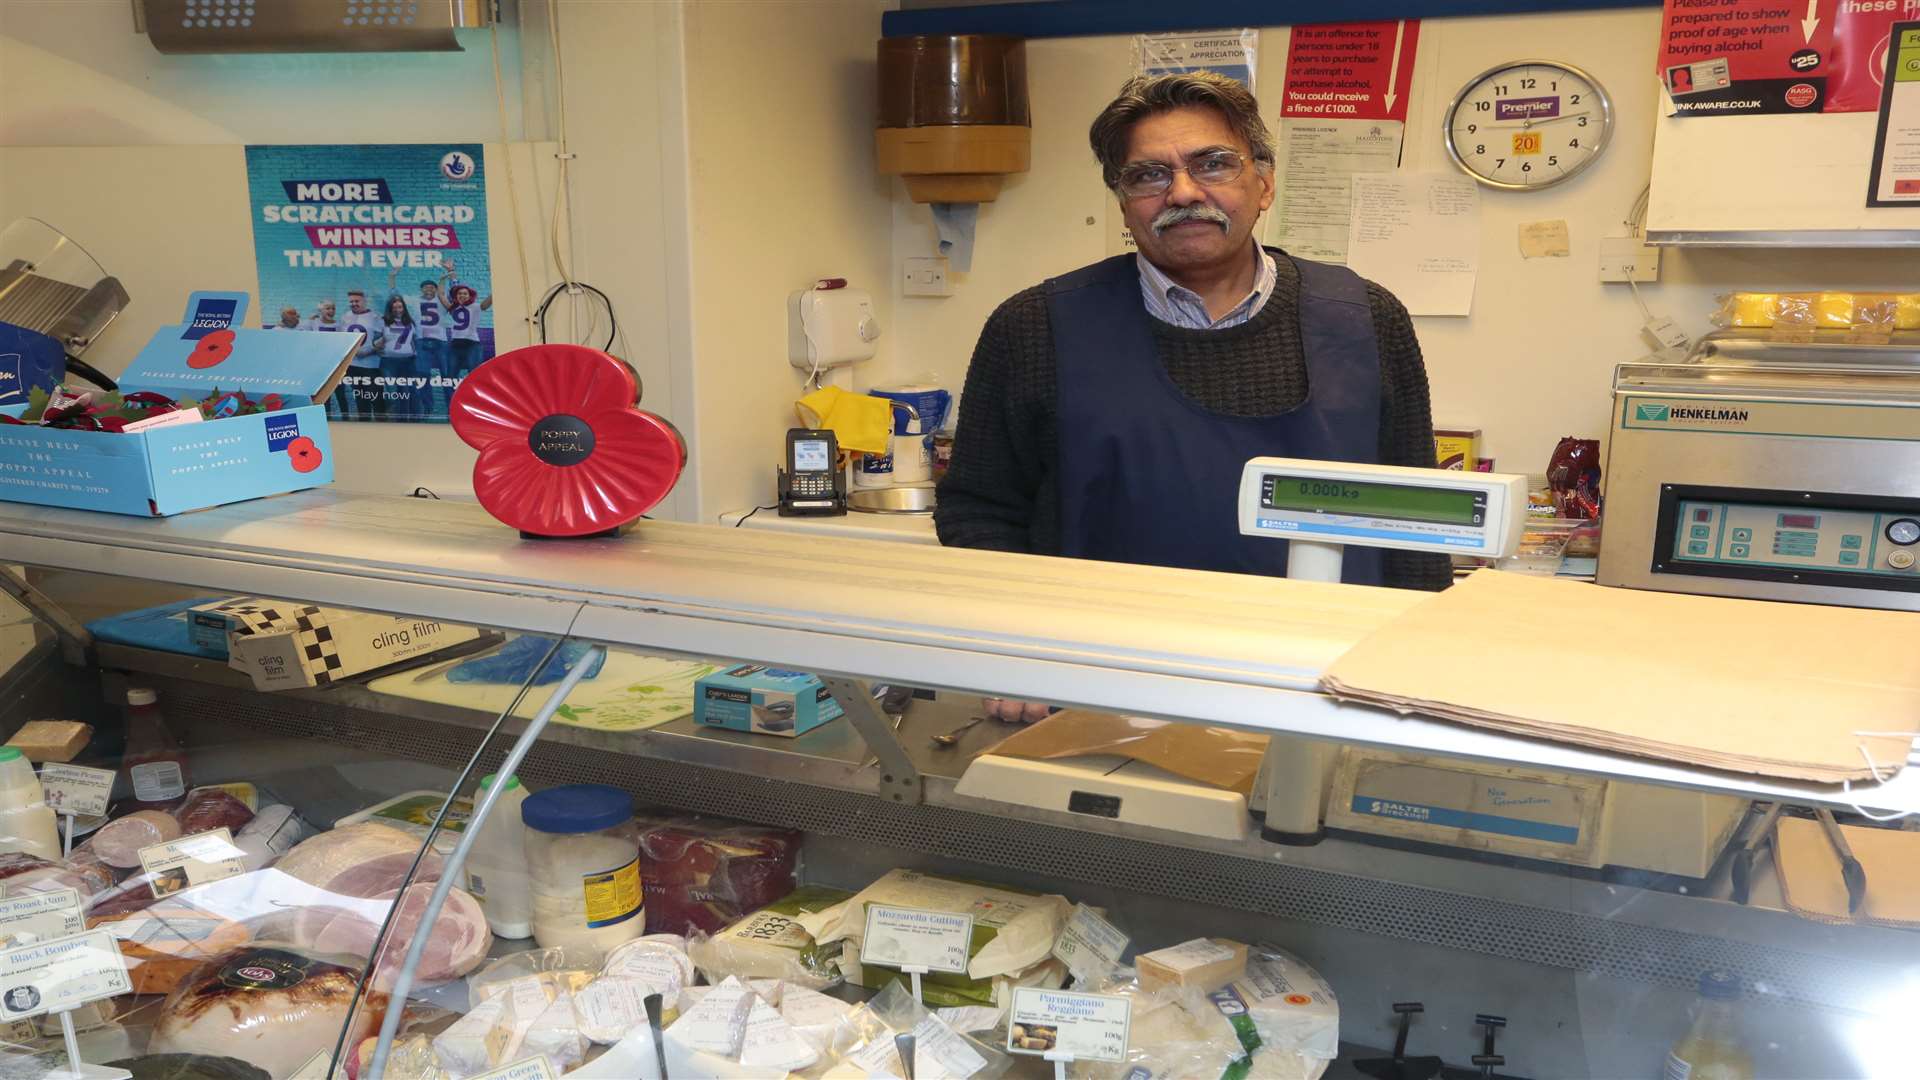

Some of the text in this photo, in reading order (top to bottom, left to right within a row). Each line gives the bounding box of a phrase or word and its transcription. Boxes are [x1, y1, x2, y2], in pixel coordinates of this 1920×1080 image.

[1673, 0, 1721, 8] Please
[1841, 0, 1897, 13] these
[1671, 8, 1790, 25] prepared to show
[1328, 30, 1364, 38] offence
[1365, 29, 1380, 38] for
[1669, 24, 1790, 40] proof of age when
[1295, 43, 1333, 51] persons
[1335, 42, 1364, 50] under
[1667, 40, 1763, 56] buying alcohol
[1190, 50, 1245, 59] APPRECIATION
[1293, 55, 1378, 65] years to purchase
[1292, 67, 1353, 77] or attempt to
[1289, 80, 1334, 90] purchase
[1520, 79, 1536, 89] 12
[1551, 81, 1557, 92] 1
[1288, 91, 1370, 101] You could receive
[1494, 86, 1508, 96] 11
[1570, 94, 1581, 105] 2
[1677, 100, 1761, 110] INKAWARE.CO.UK
[1295, 103, 1313, 112] fine
[1314, 104, 1325, 113] of
[1325, 104, 1357, 113] £1000.
[1475, 101, 1491, 112] 10
[1501, 101, 1554, 112] Premier
[1577, 116, 1588, 127] 3
[1467, 124, 1477, 134] 9
[1569, 138, 1579, 149] 4
[1476, 144, 1486, 155] 8
[1496, 159, 1505, 169] 7
[1548, 156, 1558, 166] 5
[1521, 162, 1532, 173] 6
[296, 183, 380, 201] MORE
[263, 205, 475, 223] SCRATCHCARD
[316, 228, 450, 246] WINNERS
[284, 250, 442, 268] THAN EVER
[420, 302, 440, 326] 5
[452, 307, 471, 331] 9
[193, 319, 229, 329] LEGION
[141, 371, 177, 379] PLEASE
[179, 373, 204, 381] HELP
[229, 376, 262, 385] POPPY
[374, 376, 427, 389] every
[352, 389, 411, 401] Play now
[1670, 408, 1748, 421] HENKELMAN
[268, 429, 299, 441] LEGION
[541, 431, 581, 440] POPPY
[0, 437, 80, 451] LEASE HELP
[172, 436, 243, 452] PLEASE HELP
[538, 442, 585, 452] APPEAL
[27, 453, 53, 461] THE
[200, 451, 219, 459] THE
[171, 457, 249, 475] POPPY APPEAL
[44, 468, 93, 479] APPEAL
[372, 622, 441, 649] cling film
[258, 655, 285, 666] cling
[264, 665, 285, 675] film
[1383, 802, 1431, 814] SALTER
[13, 900, 42, 910] Roast
[878, 910, 927, 922] Mozzarella
[751, 916, 791, 940] 1833
[10, 939, 89, 964] Black Bomber
[1047, 1003, 1095, 1015] Reggiano
